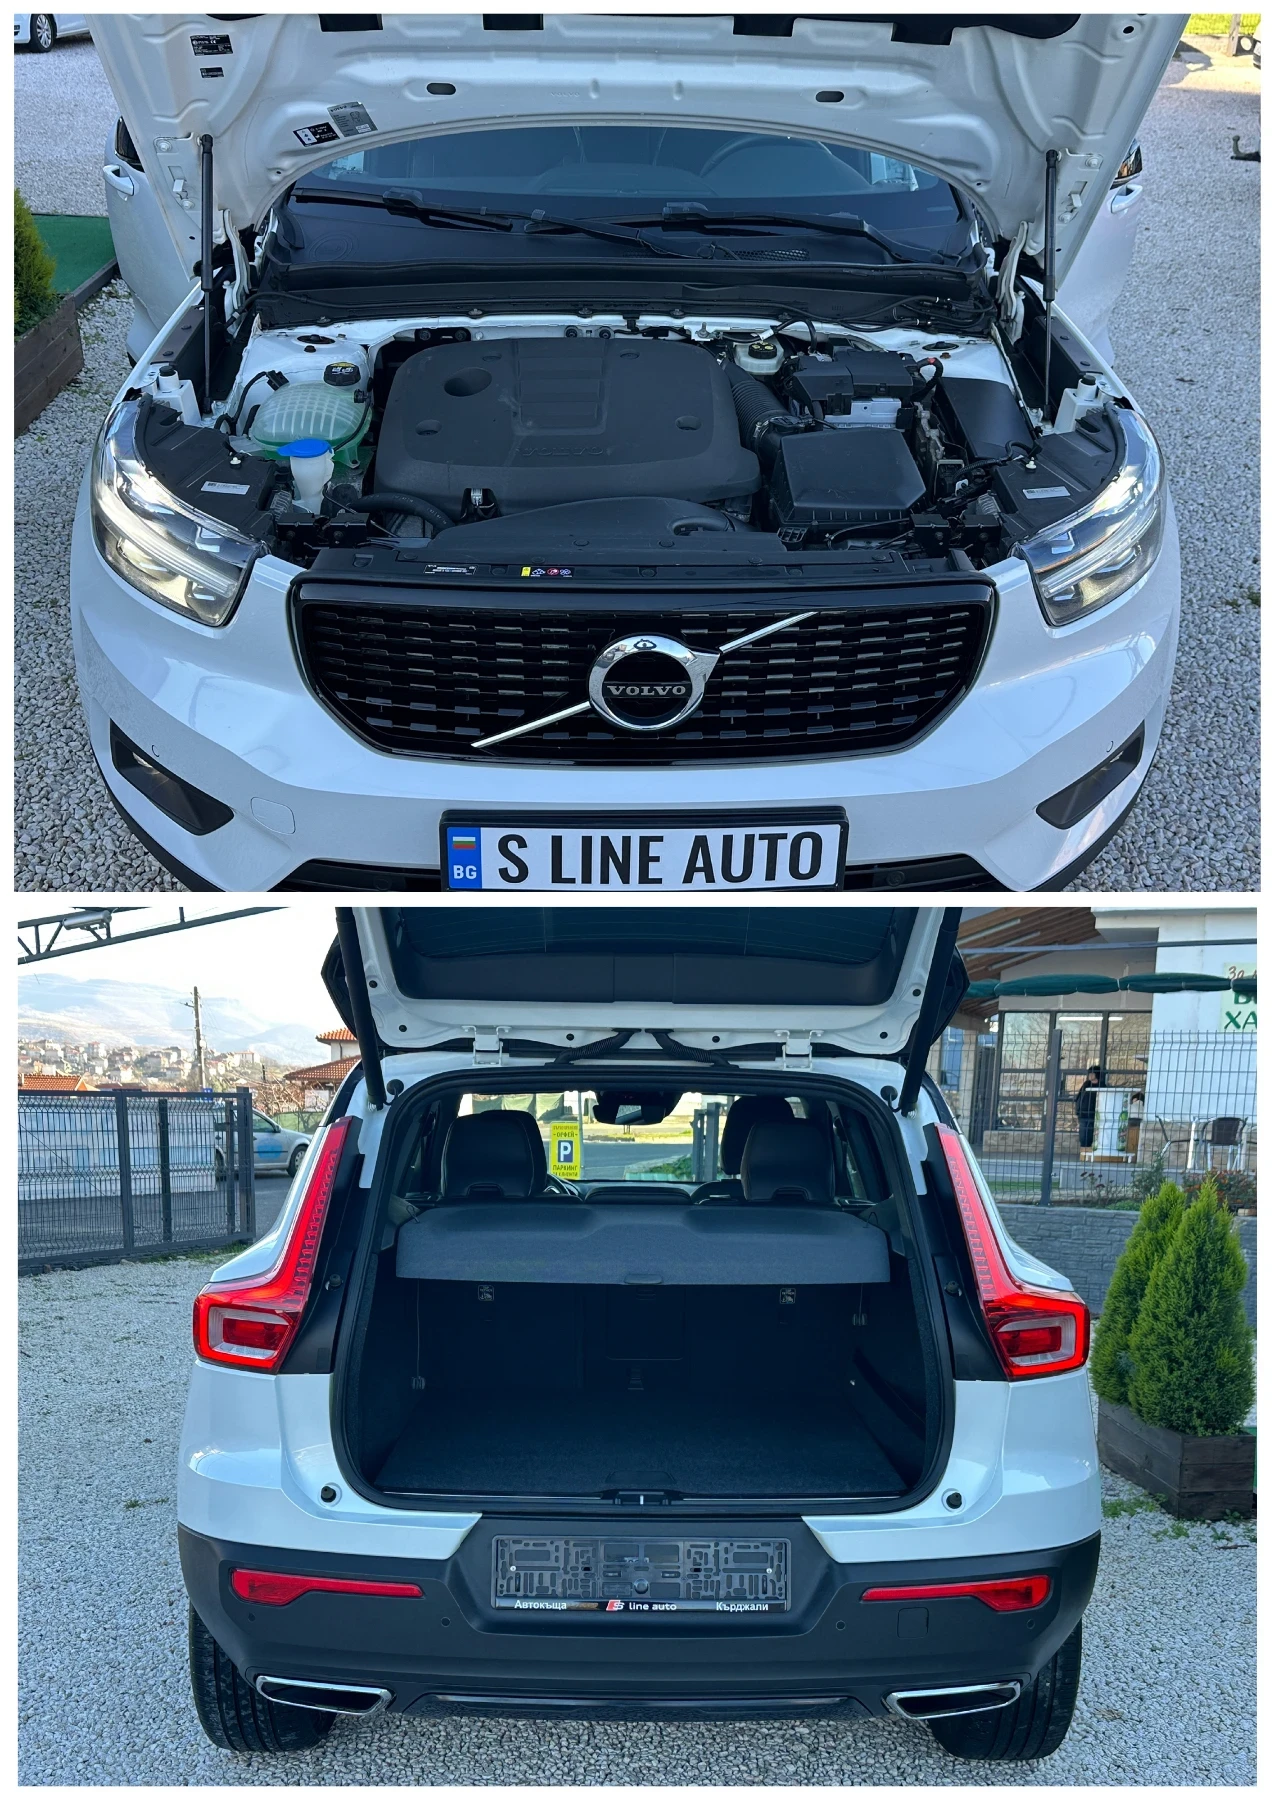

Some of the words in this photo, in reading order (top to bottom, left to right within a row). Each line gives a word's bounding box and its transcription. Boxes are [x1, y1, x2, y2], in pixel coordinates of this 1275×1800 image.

[607, 686, 686, 696] VOLVO
[497, 833, 530, 884] S
[550, 834, 664, 885] LINE
[682, 831, 824, 885] AUTO
[452, 864, 478, 880] BG
[560, 1141, 572, 1161] P
[514, 1600, 567, 1610] Автокъща
[629, 1602, 649, 1611] line
[652, 1603, 677, 1611] auto
[716, 1601, 769, 1612] Кърджали
